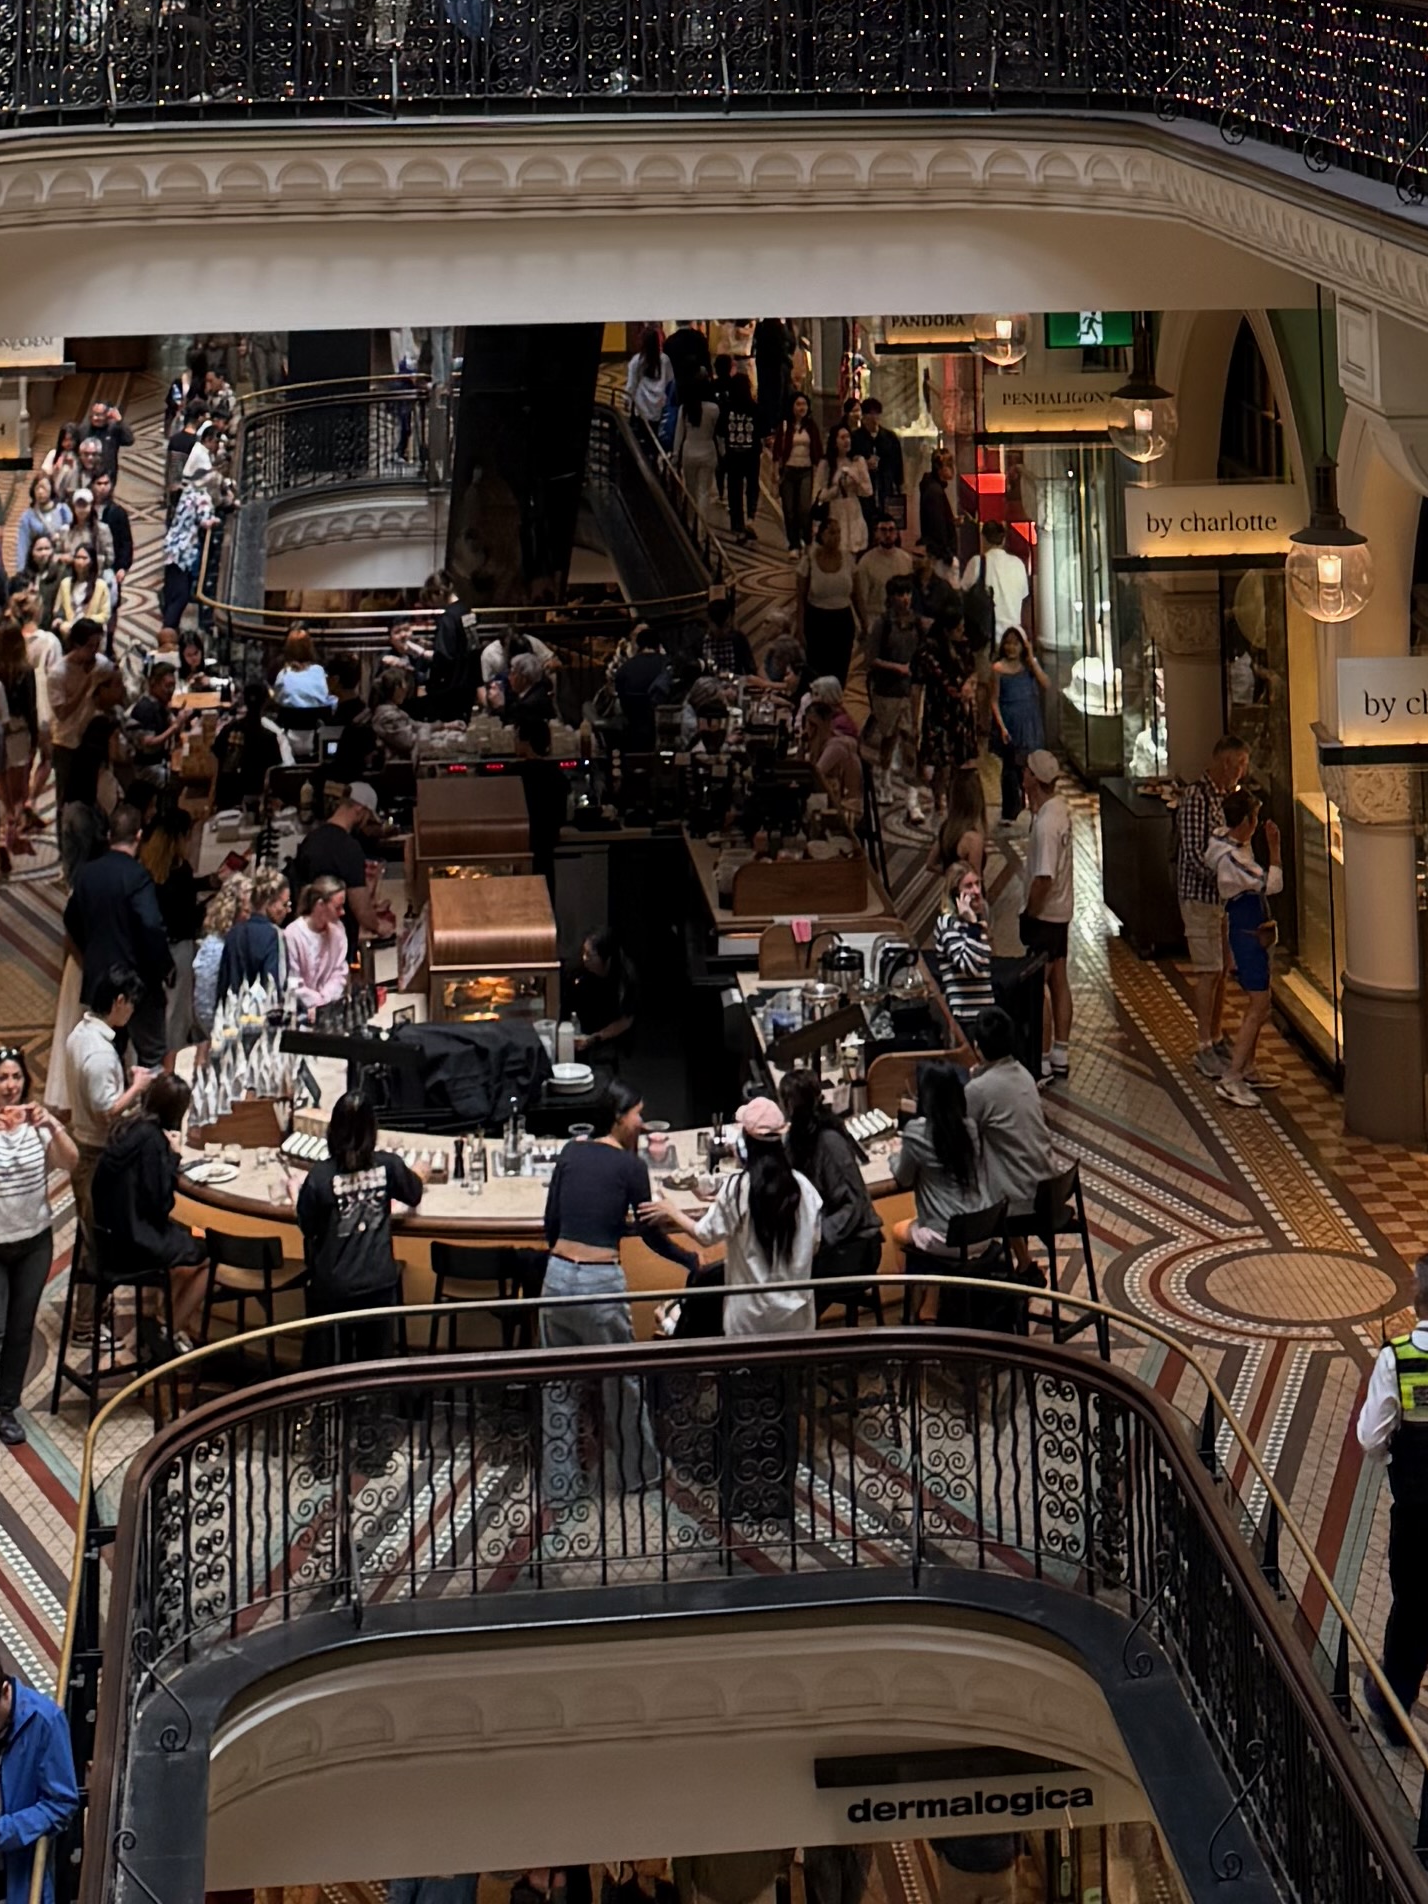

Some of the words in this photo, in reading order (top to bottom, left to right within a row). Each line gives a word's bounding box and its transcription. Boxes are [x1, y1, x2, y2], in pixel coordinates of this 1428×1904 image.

[891, 315, 966, 328] PANDORA
[1146, 511, 1173, 538] by
[1180, 507, 1278, 532] charlotte
[1363, 688, 1397, 722] by
[846, 1784, 1095, 1824] dermalogica
